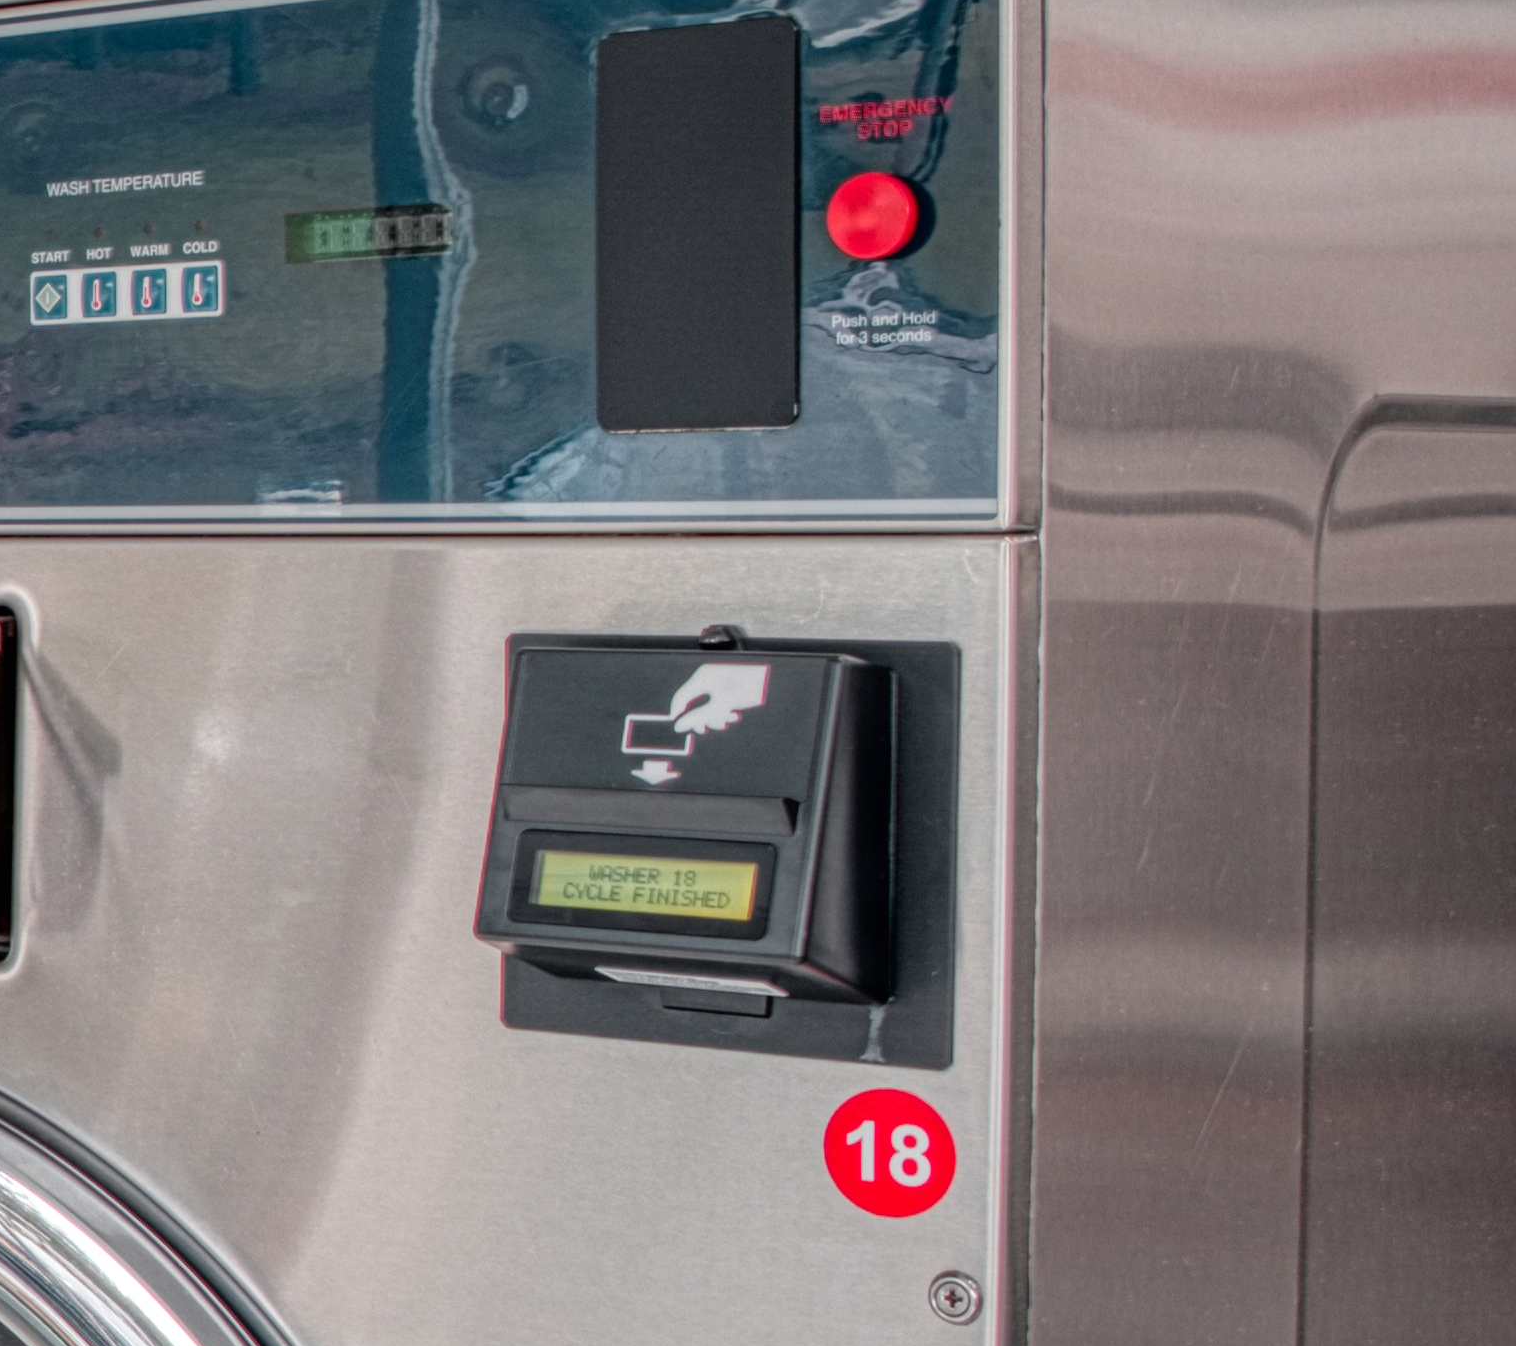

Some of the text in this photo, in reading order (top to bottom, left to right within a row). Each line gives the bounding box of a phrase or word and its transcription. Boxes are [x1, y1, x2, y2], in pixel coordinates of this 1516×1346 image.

[819, 97, 952, 123] EMERGENCY
[857, 120, 914, 140] STOP
[46, 171, 205, 197] WASH TEMPERATURE
[87, 247, 113, 260] HOT
[130, 243, 169, 257] WARM
[183, 240, 218, 254] COLD
[31, 250, 69, 264] START
[832, 311, 936, 328] Push and Hold
[836, 329, 931, 345] for 3 seconds
[589, 864, 696, 886] WASHER 18
[564, 882, 730, 909] CYCLE FINISHED
[846, 1120, 931, 1187] 18
